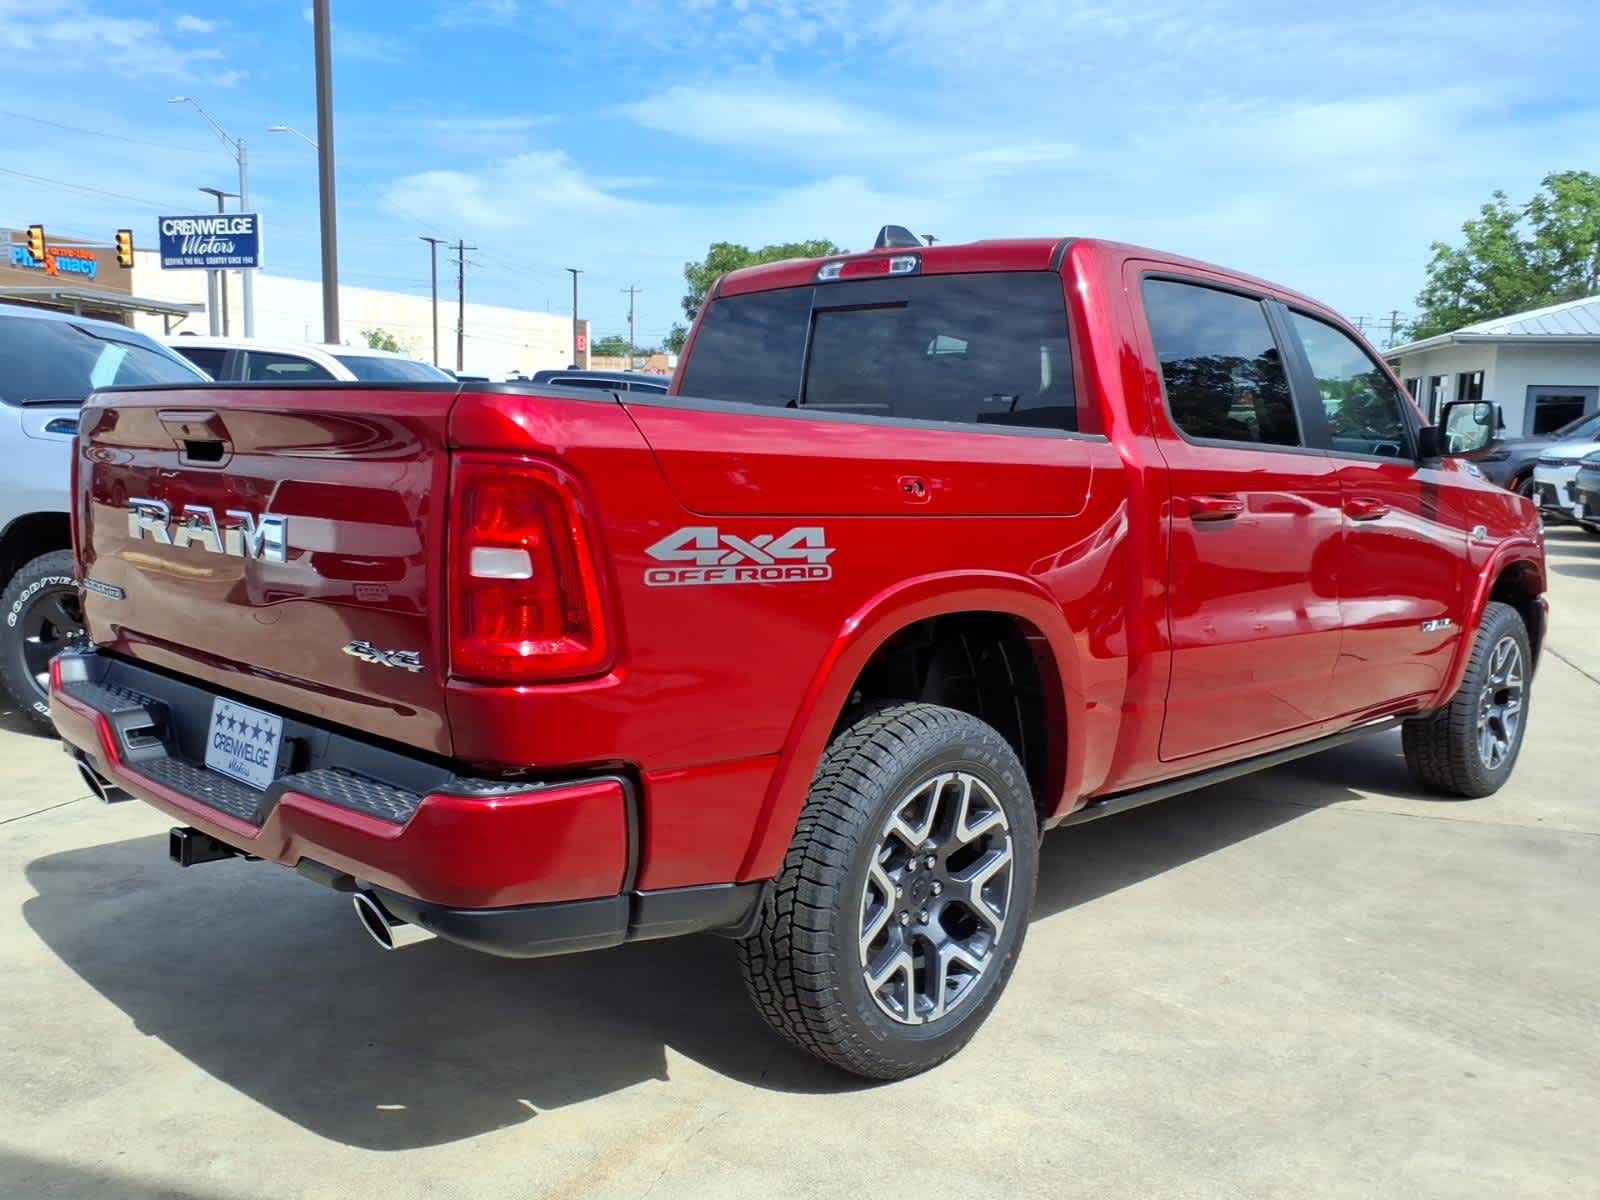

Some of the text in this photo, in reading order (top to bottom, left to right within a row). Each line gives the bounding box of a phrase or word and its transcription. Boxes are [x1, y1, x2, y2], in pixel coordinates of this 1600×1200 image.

[162, 218, 253, 236] CRENWELGE
[181, 235, 235, 255] Motors
[128, 498, 288, 563] RAM
[643, 526, 837, 566] 4x4
[649, 566, 829, 583] OFF ROAD
[214, 732, 270, 768] CRENWELGE
